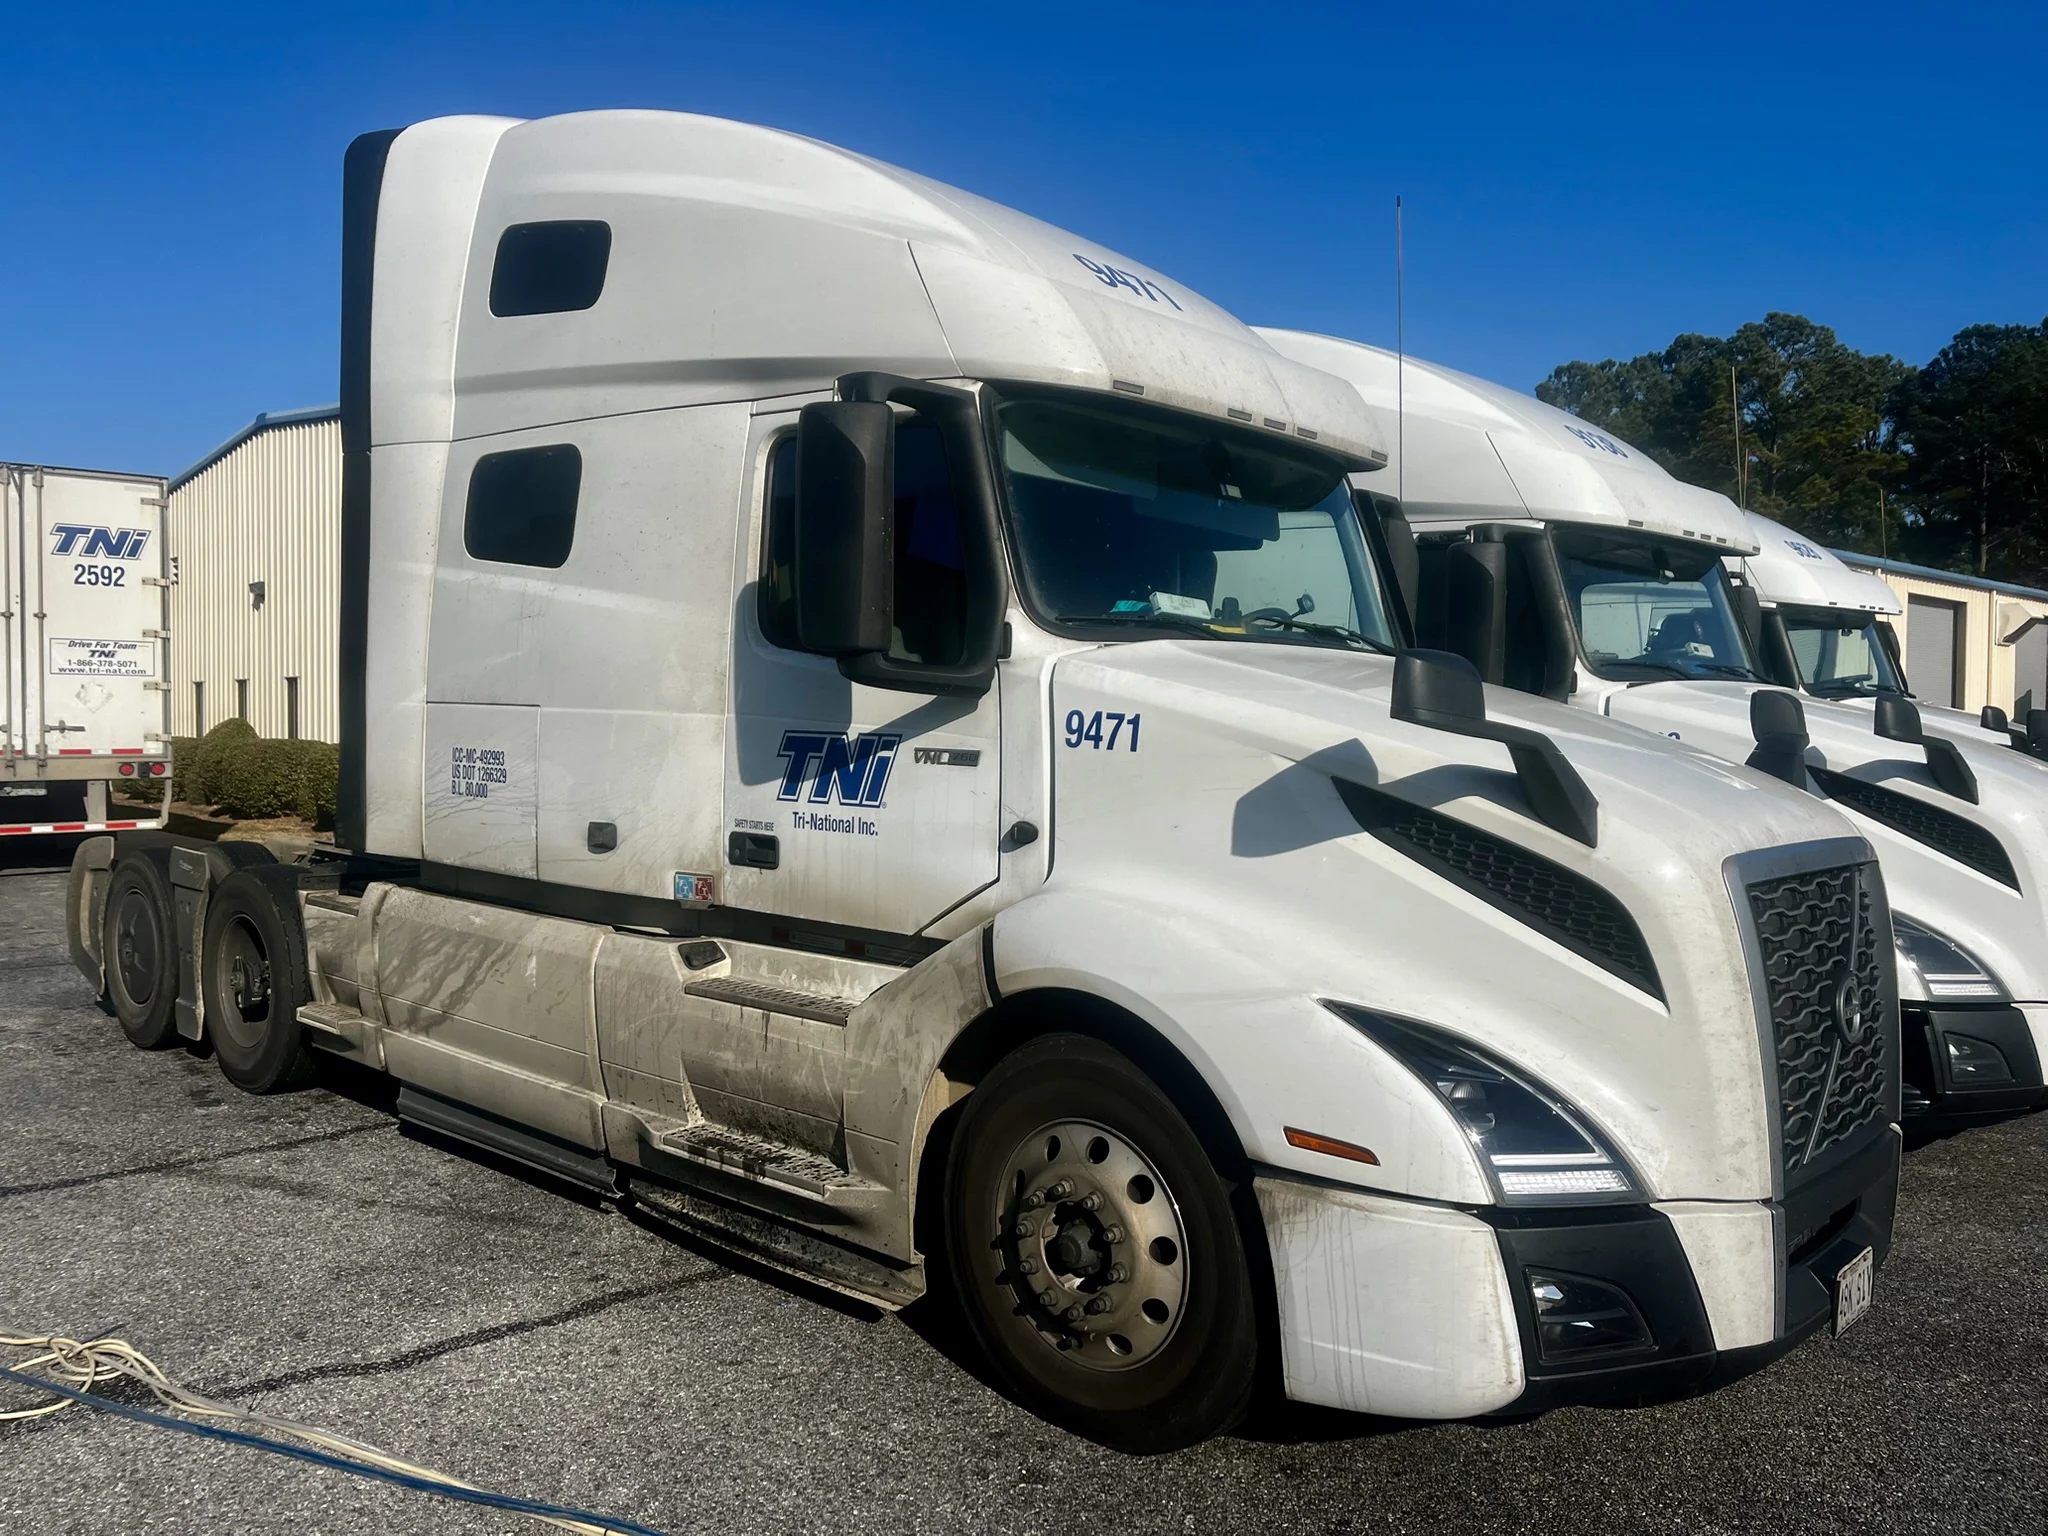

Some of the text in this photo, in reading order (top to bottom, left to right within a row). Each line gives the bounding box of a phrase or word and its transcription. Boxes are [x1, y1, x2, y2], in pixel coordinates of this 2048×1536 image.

[1072, 253, 1184, 312] 9471
[73, 563, 125, 587] 2592
[67, 640, 137, 650] Drive For Team
[58, 667, 147, 675] www.tri-nat.com
[67, 659, 137, 668] 1-866-378-5071
[1065, 709, 1141, 753] 9471
[451, 747, 505, 766] ICC-MC-492993
[451, 763, 507, 784] US DOT 1266329
[451, 779, 488, 800] B.L. 80,000
[734, 818, 775, 832] SAFETY STARTS HERE
[792, 811, 879, 836] Tri-National Inc.
